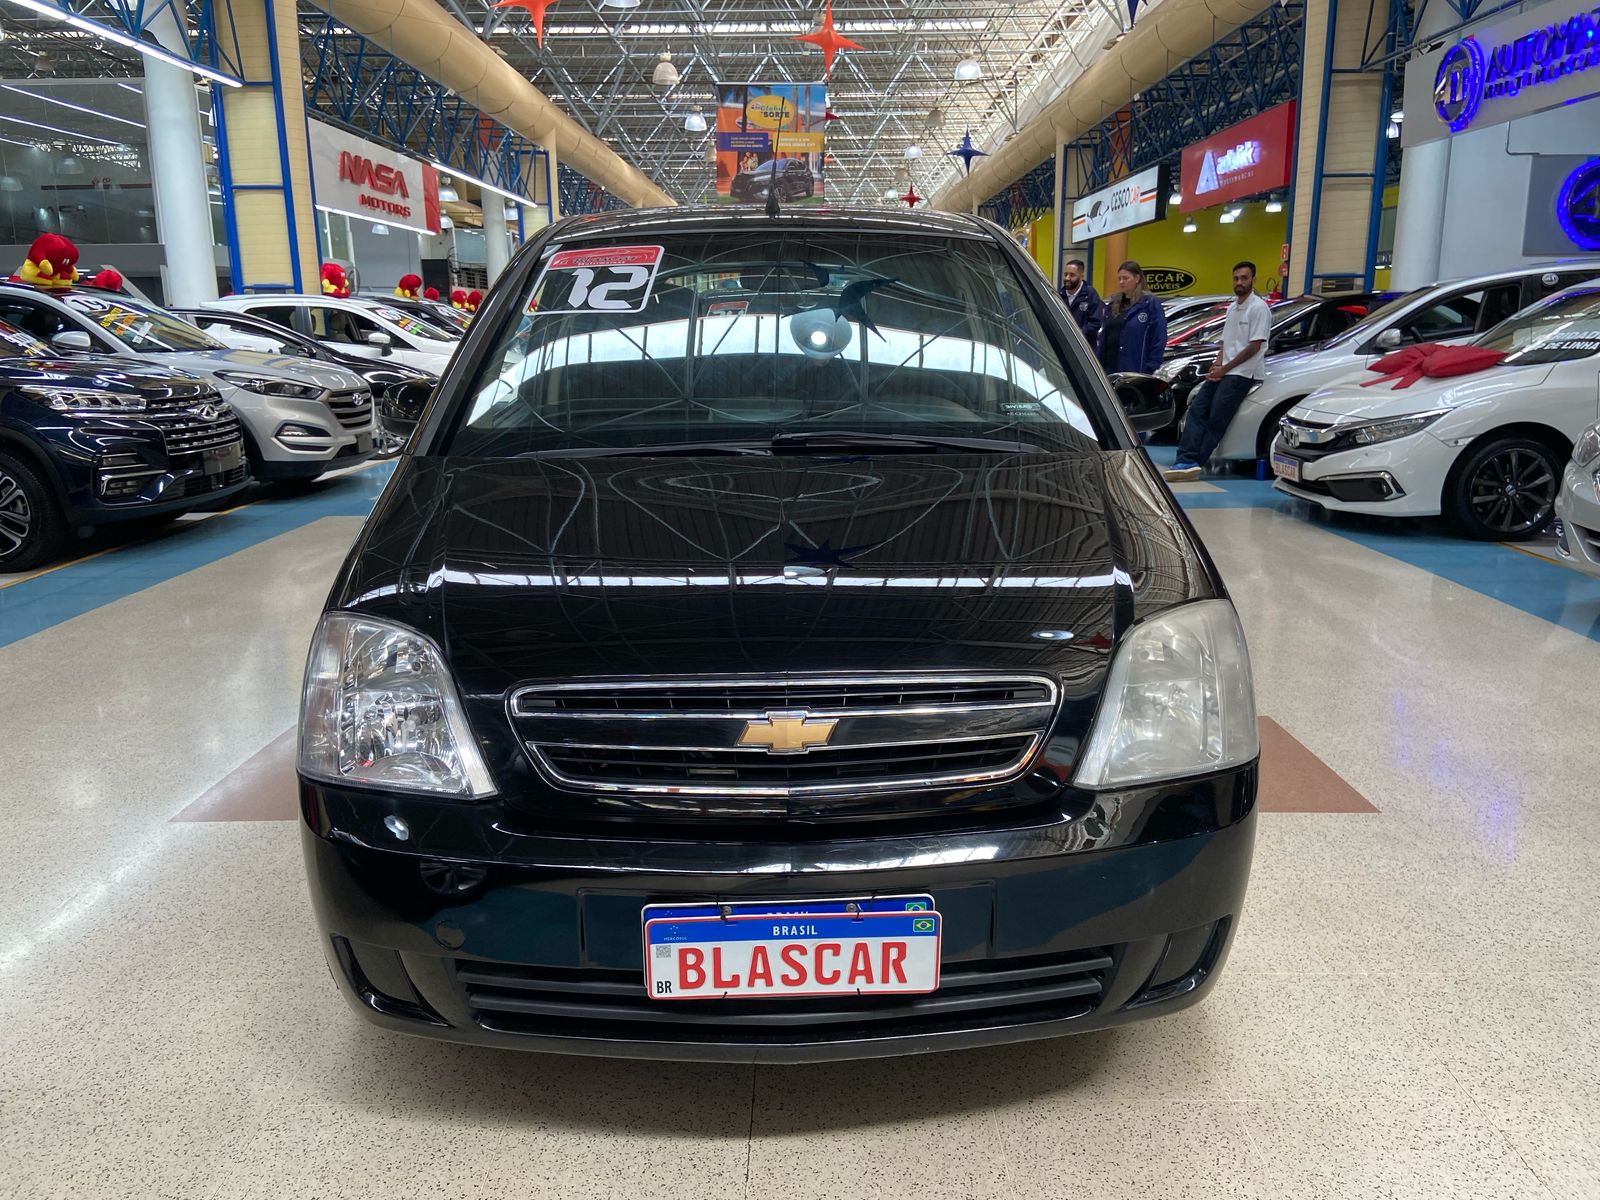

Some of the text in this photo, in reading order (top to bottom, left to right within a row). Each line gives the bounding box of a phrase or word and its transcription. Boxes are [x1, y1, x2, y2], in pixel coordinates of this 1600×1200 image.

[1484, 49, 1600, 99] MULTIMARCA
[337, 150, 410, 200] NASA
[357, 194, 412, 218] MOTORS
[1146, 273, 1184, 282] ECAR
[1147, 282, 1181, 290] MÓVEIS
[567, 266, 649, 309] 12
[1544, 342, 1563, 350] DE
[1561, 341, 1599, 350] LINHA
[772, 925, 818, 936] BRASIL
[678, 941, 908, 990] BLASCAR
[656, 980, 672, 994] BR
